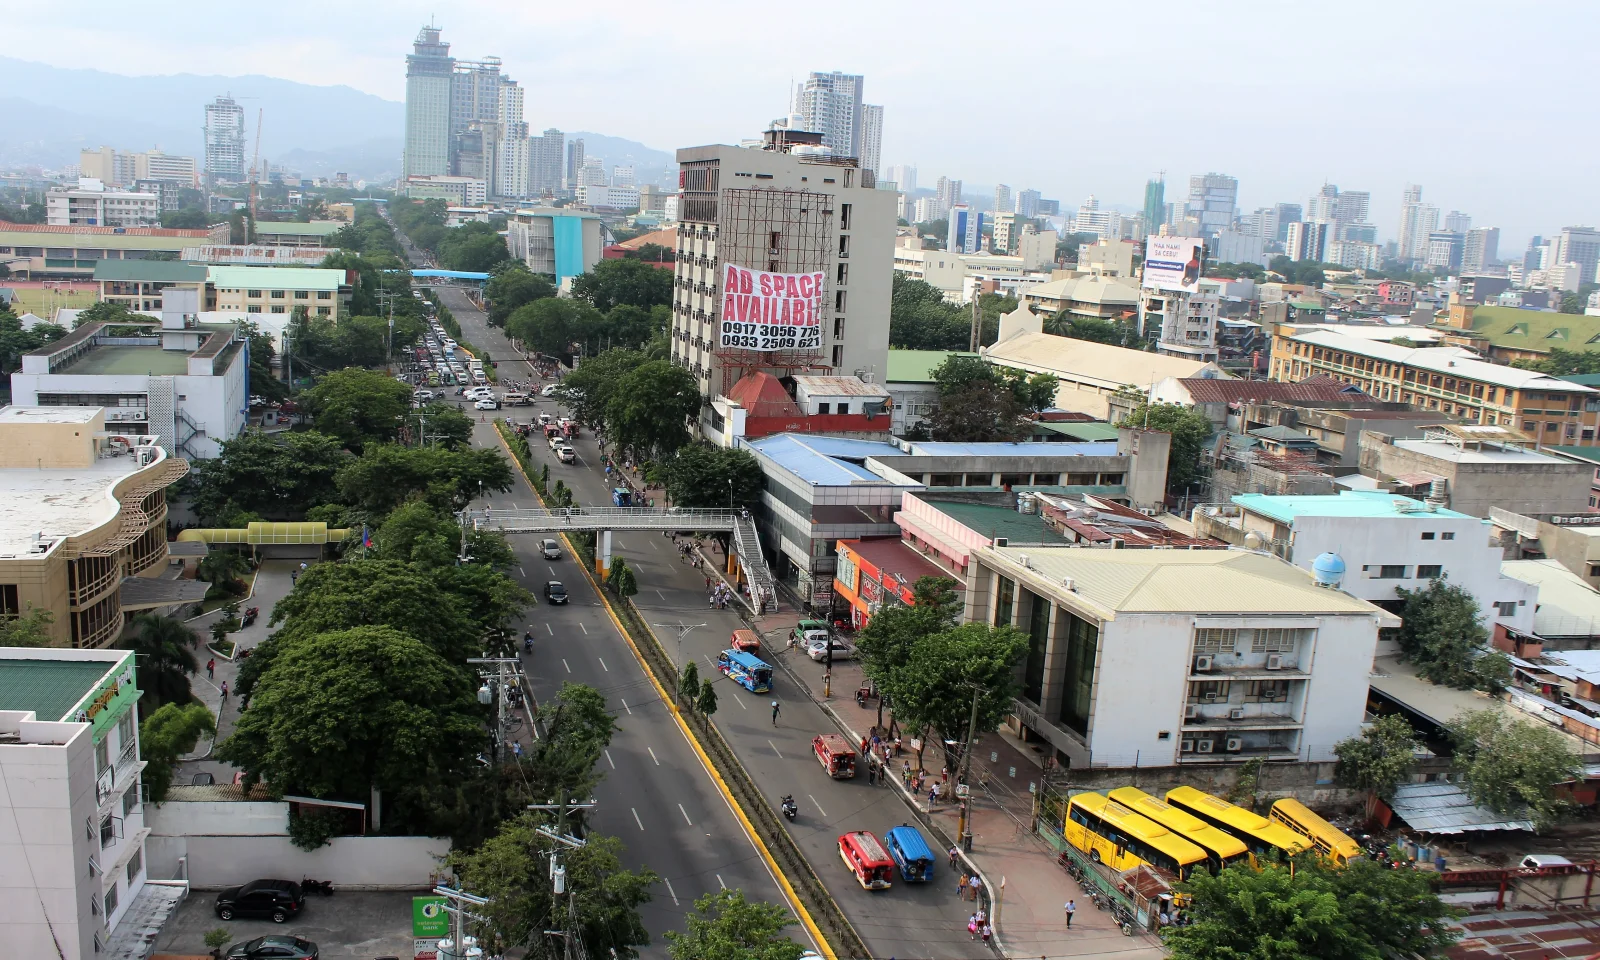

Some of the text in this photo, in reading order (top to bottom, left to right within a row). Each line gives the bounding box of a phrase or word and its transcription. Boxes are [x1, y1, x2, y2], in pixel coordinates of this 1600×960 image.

[725, 266, 822, 298] AD SPACE
[723, 294, 821, 326] AVAILABLE
[722, 322, 756, 335] 0917
[760, 326, 796, 337] 3056
[722, 335, 819, 349] 0933 2509 621
